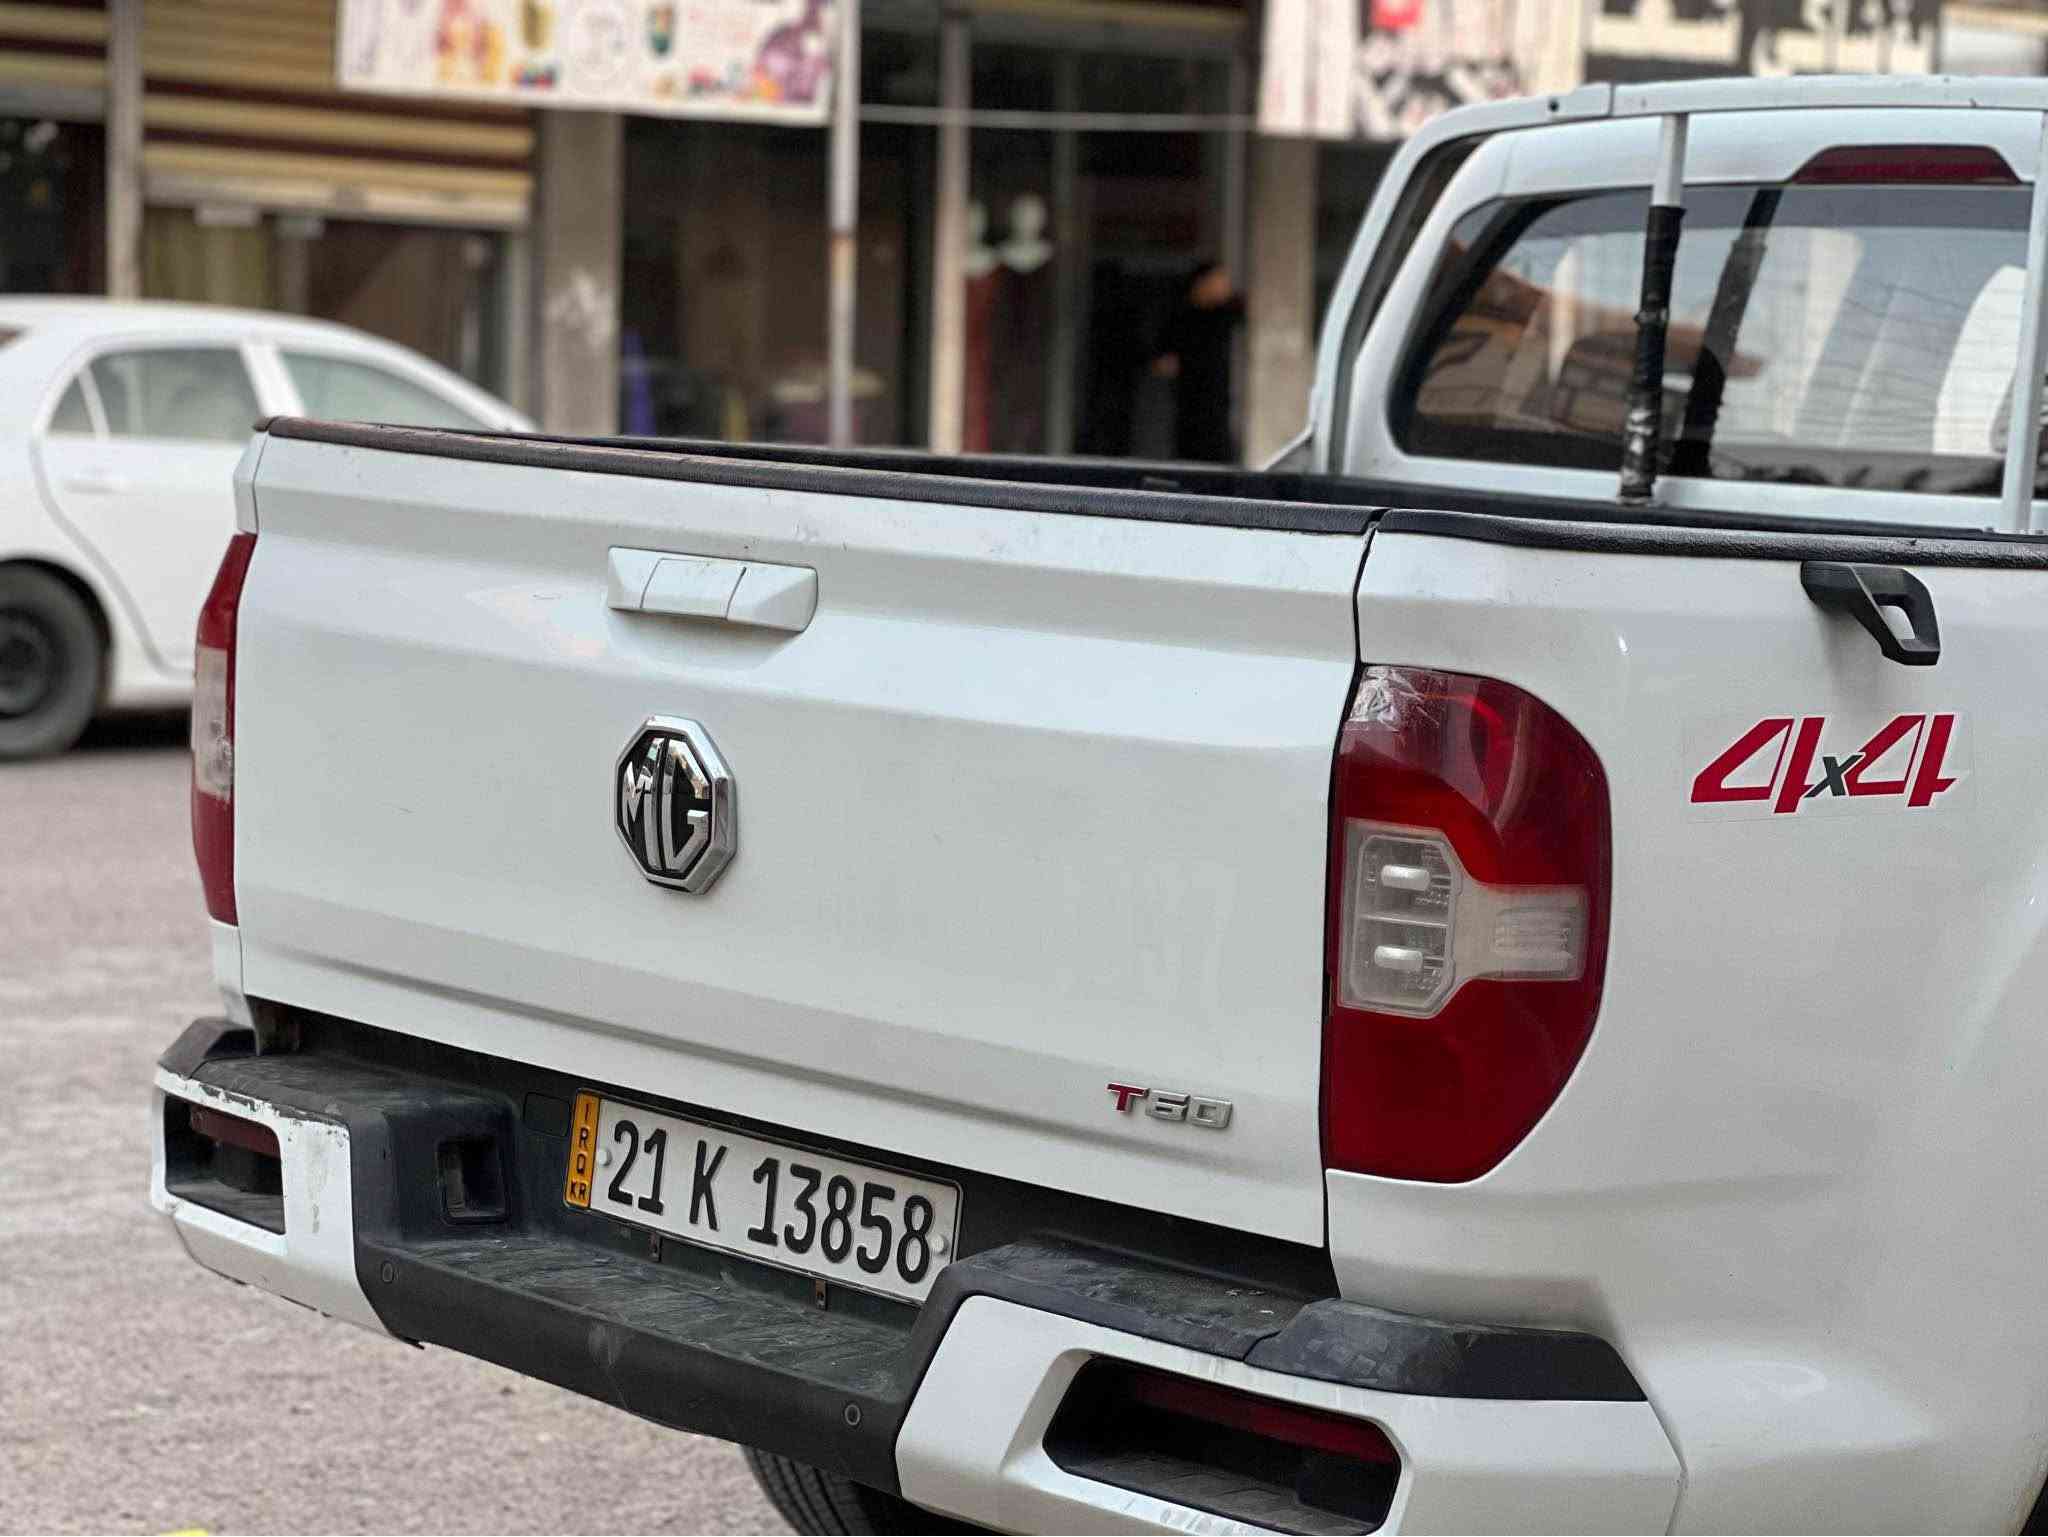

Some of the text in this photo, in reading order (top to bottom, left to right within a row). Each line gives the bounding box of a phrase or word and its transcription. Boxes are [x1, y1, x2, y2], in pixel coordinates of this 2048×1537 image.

[622, 737, 711, 873] MG
[576, 1103, 590, 1175] IRQ
[1107, 1082, 1233, 1128] T60
[569, 1181, 587, 1200] KR
[607, 1119, 933, 1284] 21 K 13858
